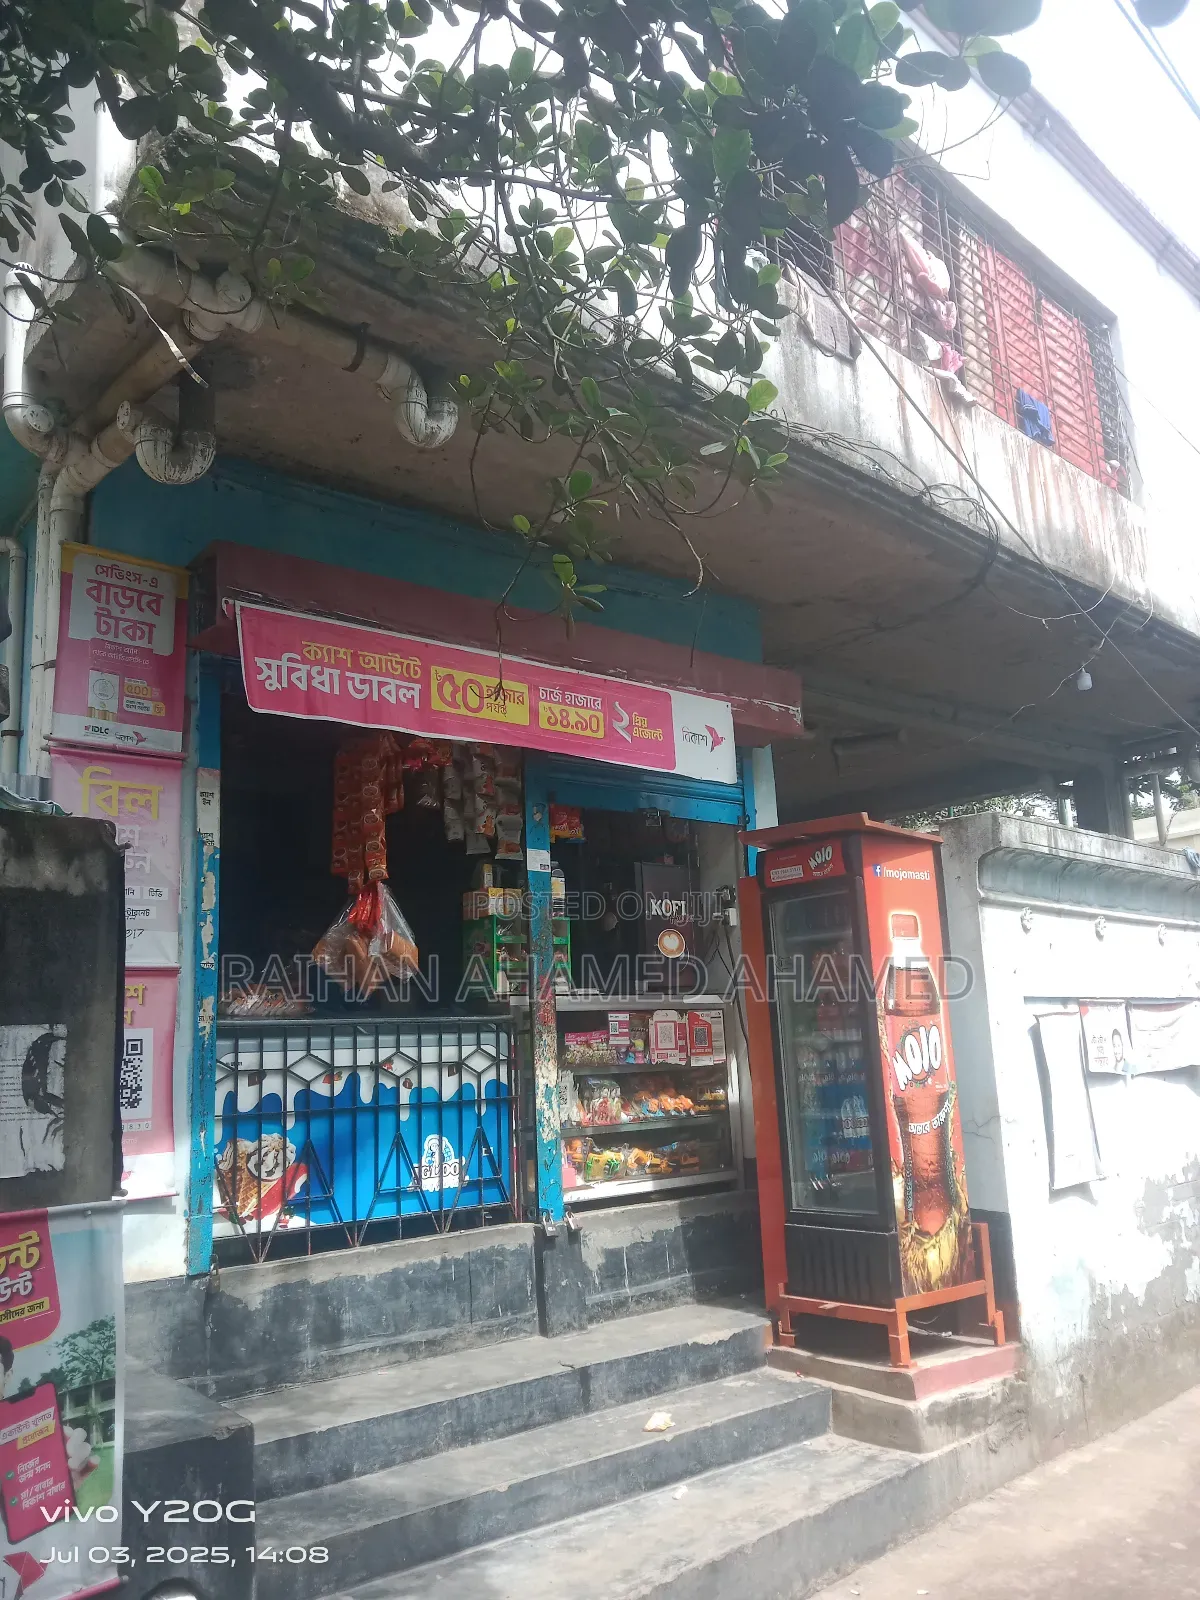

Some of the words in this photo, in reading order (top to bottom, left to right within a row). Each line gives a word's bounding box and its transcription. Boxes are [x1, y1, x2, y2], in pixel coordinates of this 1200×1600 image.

[86, 578, 164, 617] বাড়বে
[94, 606, 157, 645] টাকা
[301, 640, 352, 669] ক্যাশ
[359, 650, 422, 679] আউটে
[254, 652, 341, 695] সুবিধা
[345, 670, 422, 709] ডাবল
[564, 691, 603, 710] হাজারে
[91, 725, 110, 735] IDLC
[611, 700, 633, 744] ২
[77, 765, 164, 820] বিল
[650, 899, 687, 917] KOFI
[892, 1025, 941, 1092] MOJO
